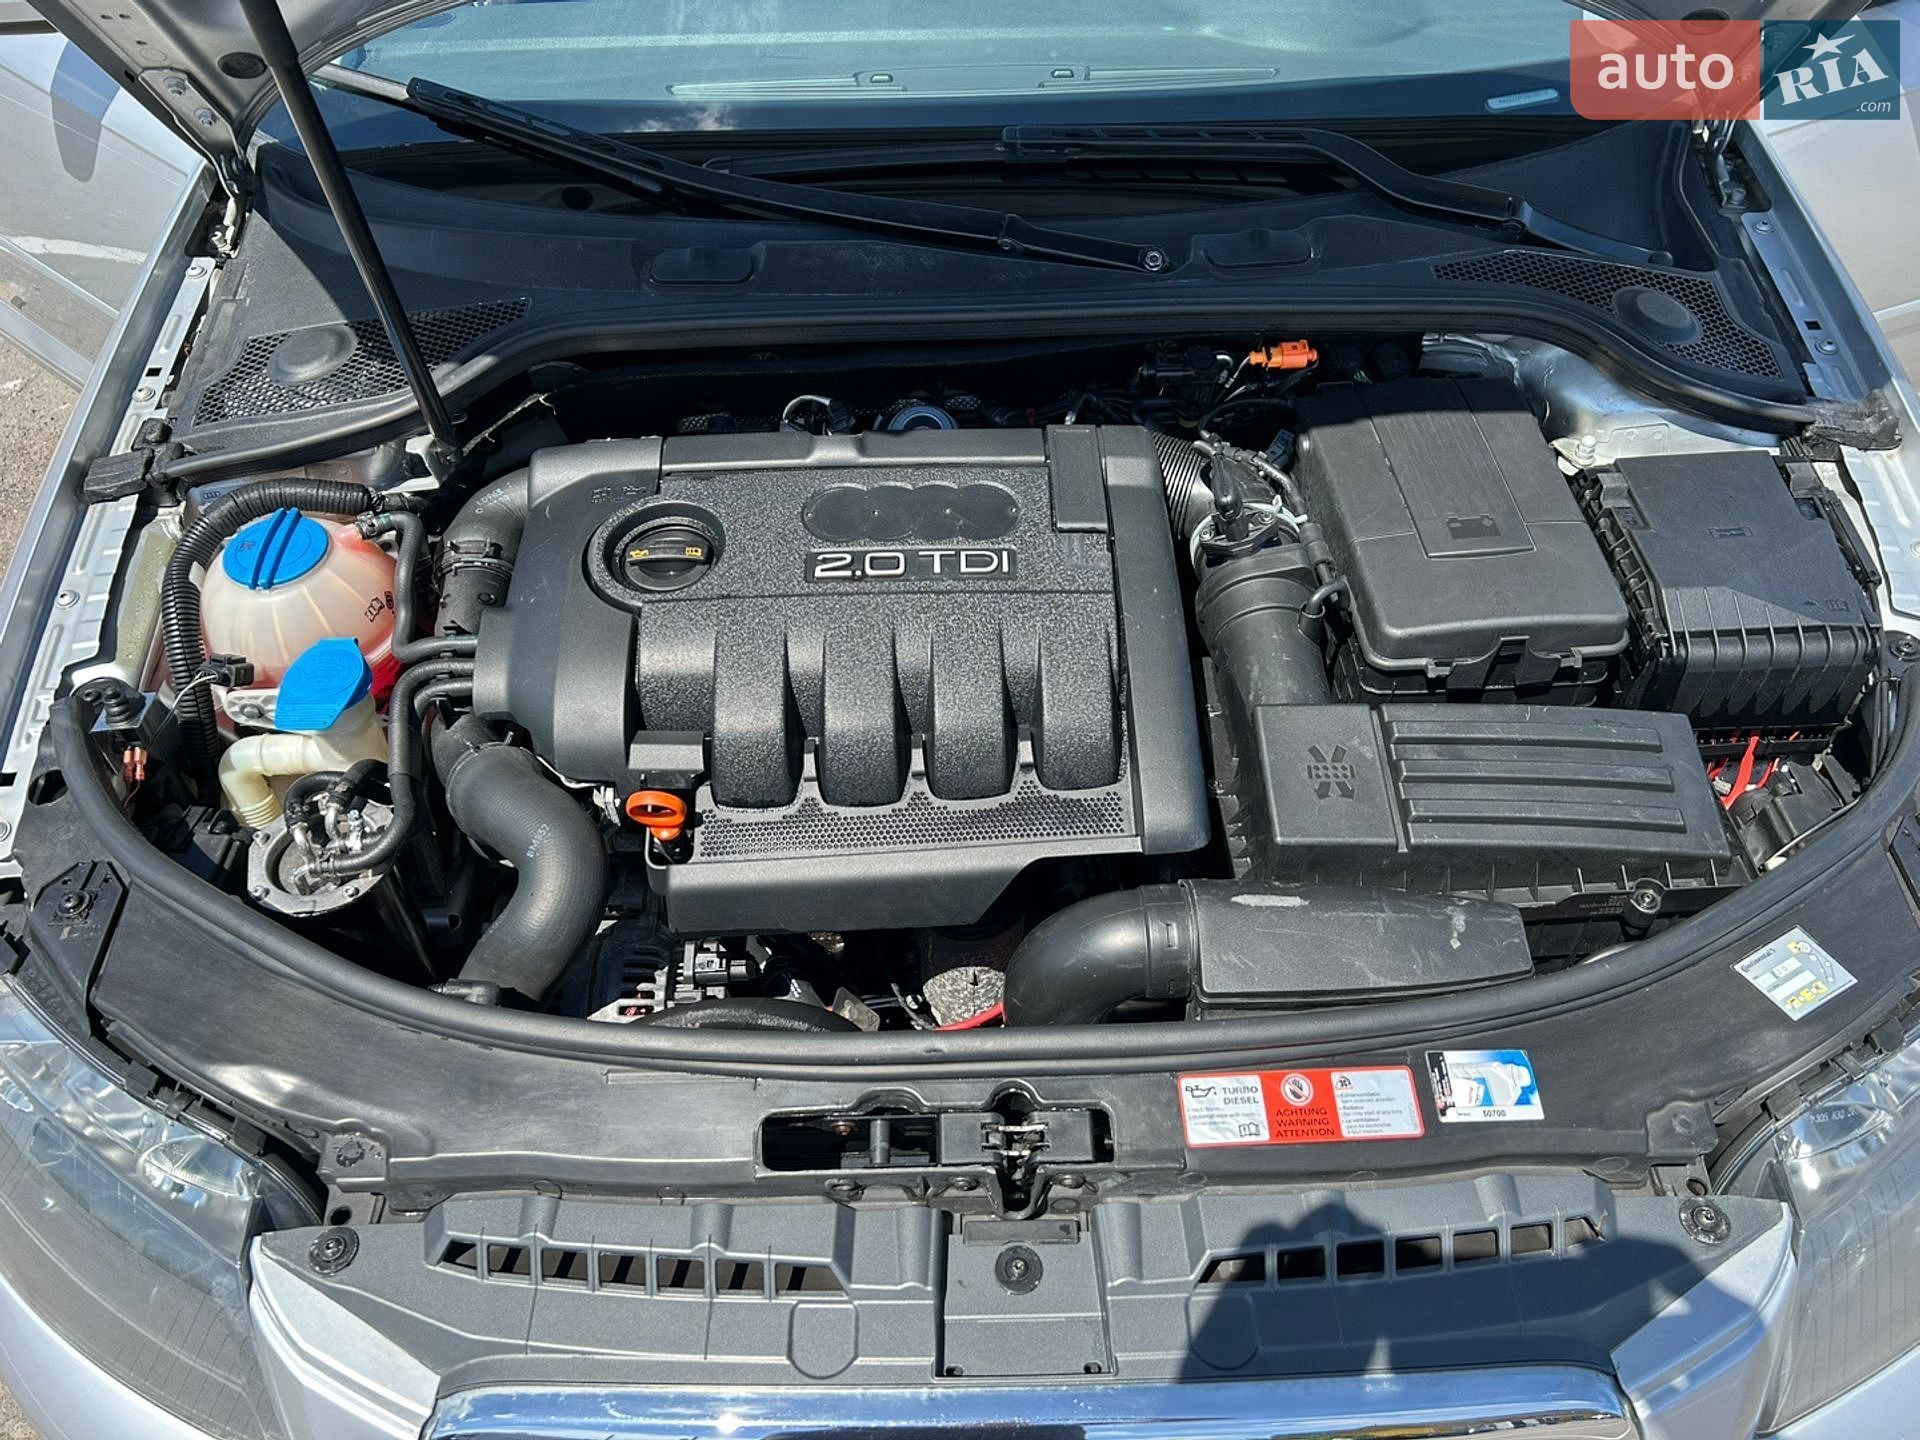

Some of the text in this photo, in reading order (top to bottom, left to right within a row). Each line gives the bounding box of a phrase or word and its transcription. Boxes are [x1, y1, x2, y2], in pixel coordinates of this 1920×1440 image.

[814, 550, 1010, 579] 2.0 TDI
[1221, 1086, 1259, 1095] TURBO
[1223, 1096, 1260, 1106] DIESEL
[1276, 1107, 1328, 1118] ACHTUNG
[1276, 1117, 1330, 1128] WARNING
[1276, 1128, 1335, 1138] ATTENTION
